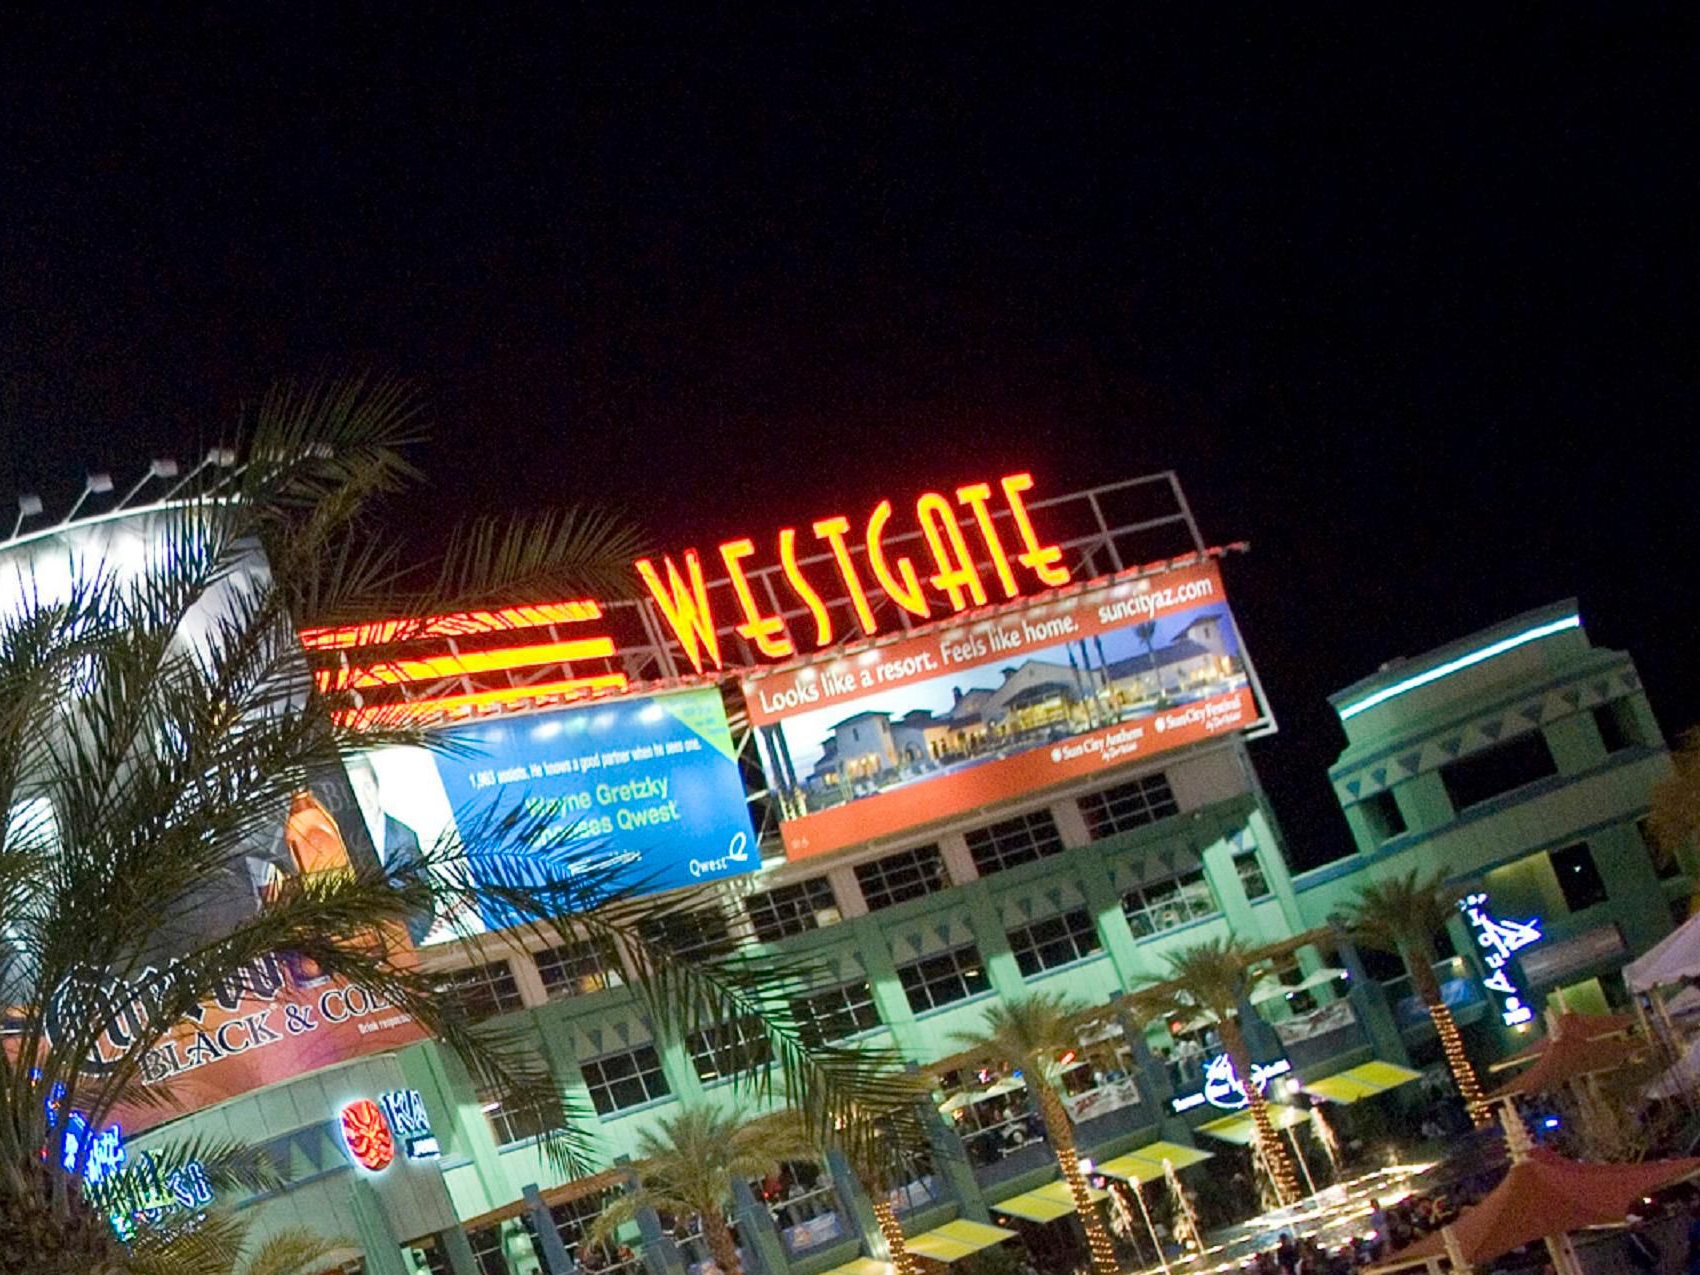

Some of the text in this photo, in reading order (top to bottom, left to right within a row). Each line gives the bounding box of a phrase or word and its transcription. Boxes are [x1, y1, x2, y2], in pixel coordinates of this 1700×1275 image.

[635, 472, 1071, 673] WESTGATE
[759, 577, 1213, 714] Looks like a resort. Feels like home. suncityaz.com
[596, 776, 669, 805] Gretzky
[617, 800, 680, 831] Qwest
[689, 855, 728, 878] Qwest
[142, 1013, 284, 1087] BLACK
[285, 1002, 318, 1034] &
